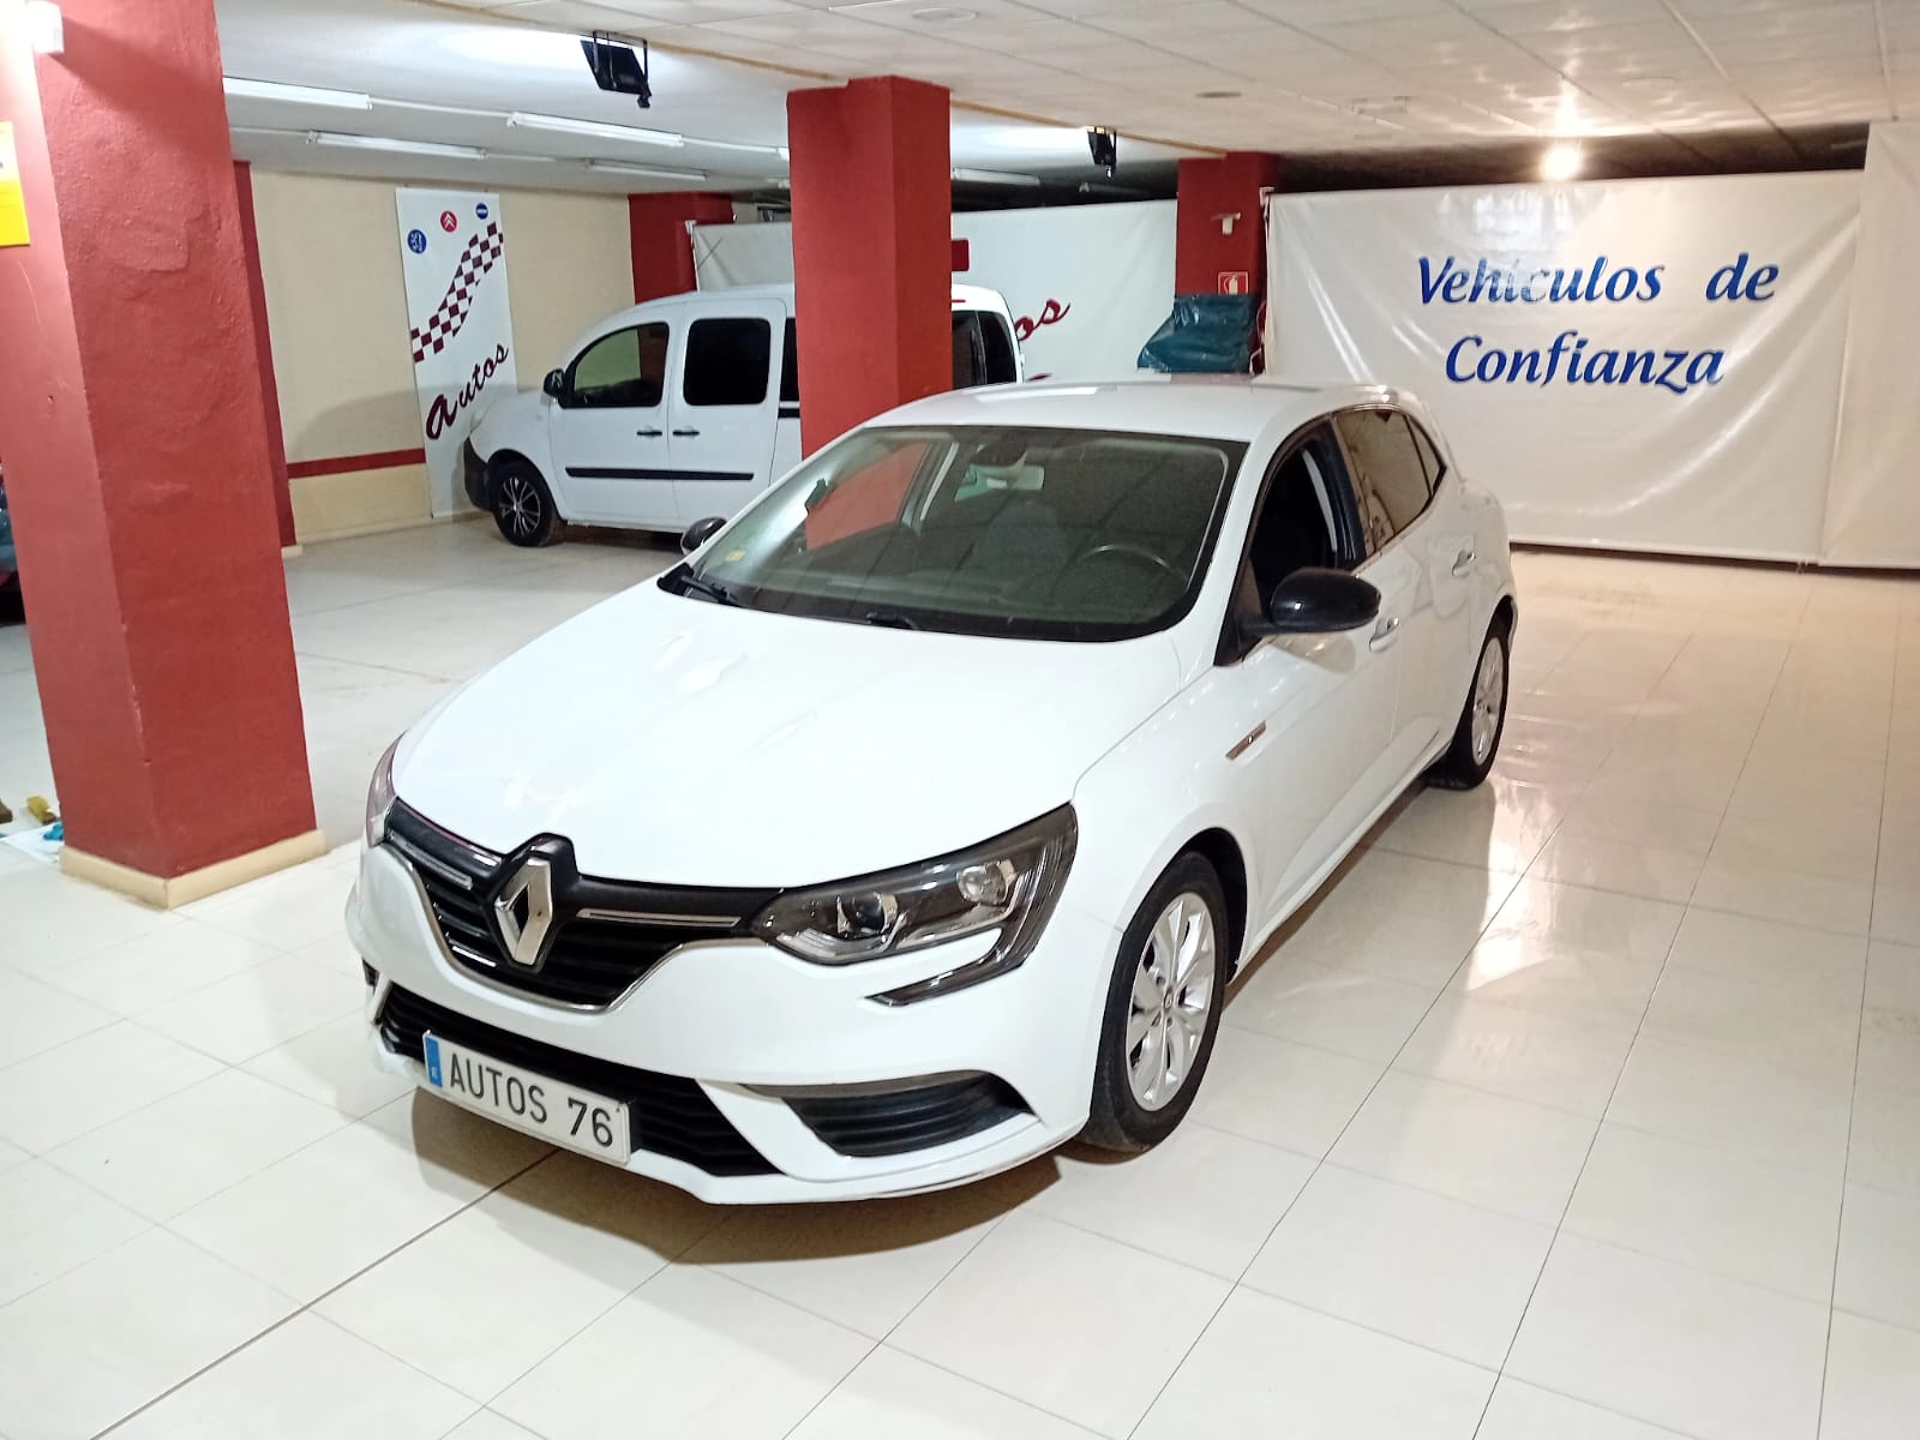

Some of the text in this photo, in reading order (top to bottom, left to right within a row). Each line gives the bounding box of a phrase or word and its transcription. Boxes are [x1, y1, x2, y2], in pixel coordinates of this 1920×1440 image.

[1706, 252, 1780, 302] de
[1446, 329, 1725, 395] Confianza
[449, 1053, 613, 1147] AUTOS 76
